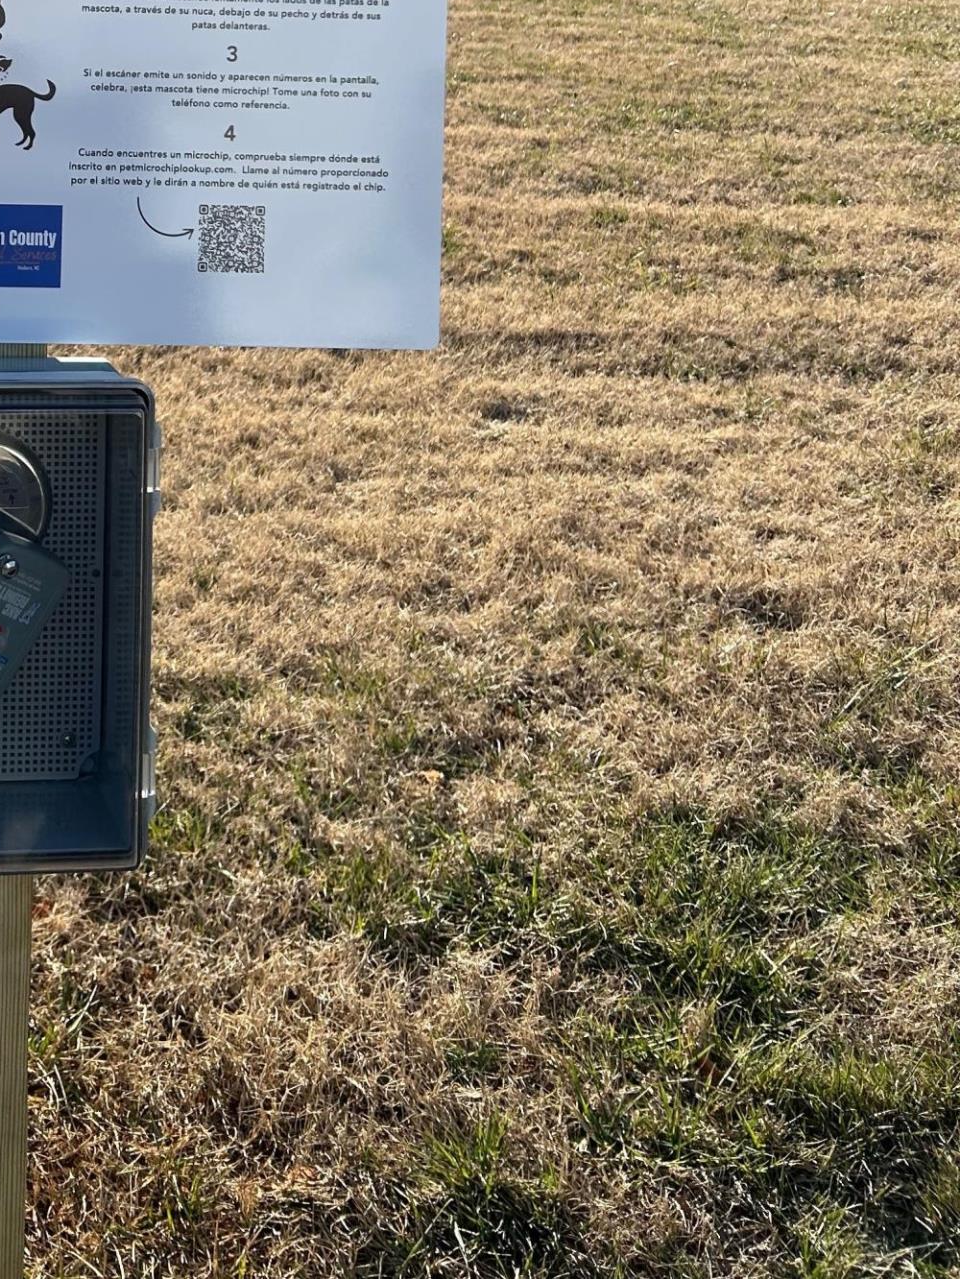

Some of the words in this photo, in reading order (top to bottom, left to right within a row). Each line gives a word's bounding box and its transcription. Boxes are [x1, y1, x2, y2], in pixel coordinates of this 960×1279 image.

[191, 21, 217, 31] patas
[218, 20, 270, 31] delanteras.
[225, 44, 238, 62] 3
[170, 97, 211, 108] teléfono
[212, 100, 239, 109] como
[240, 99, 290, 110] referencia.
[223, 124, 236, 142] 4
[8, 229, 57, 248] County
